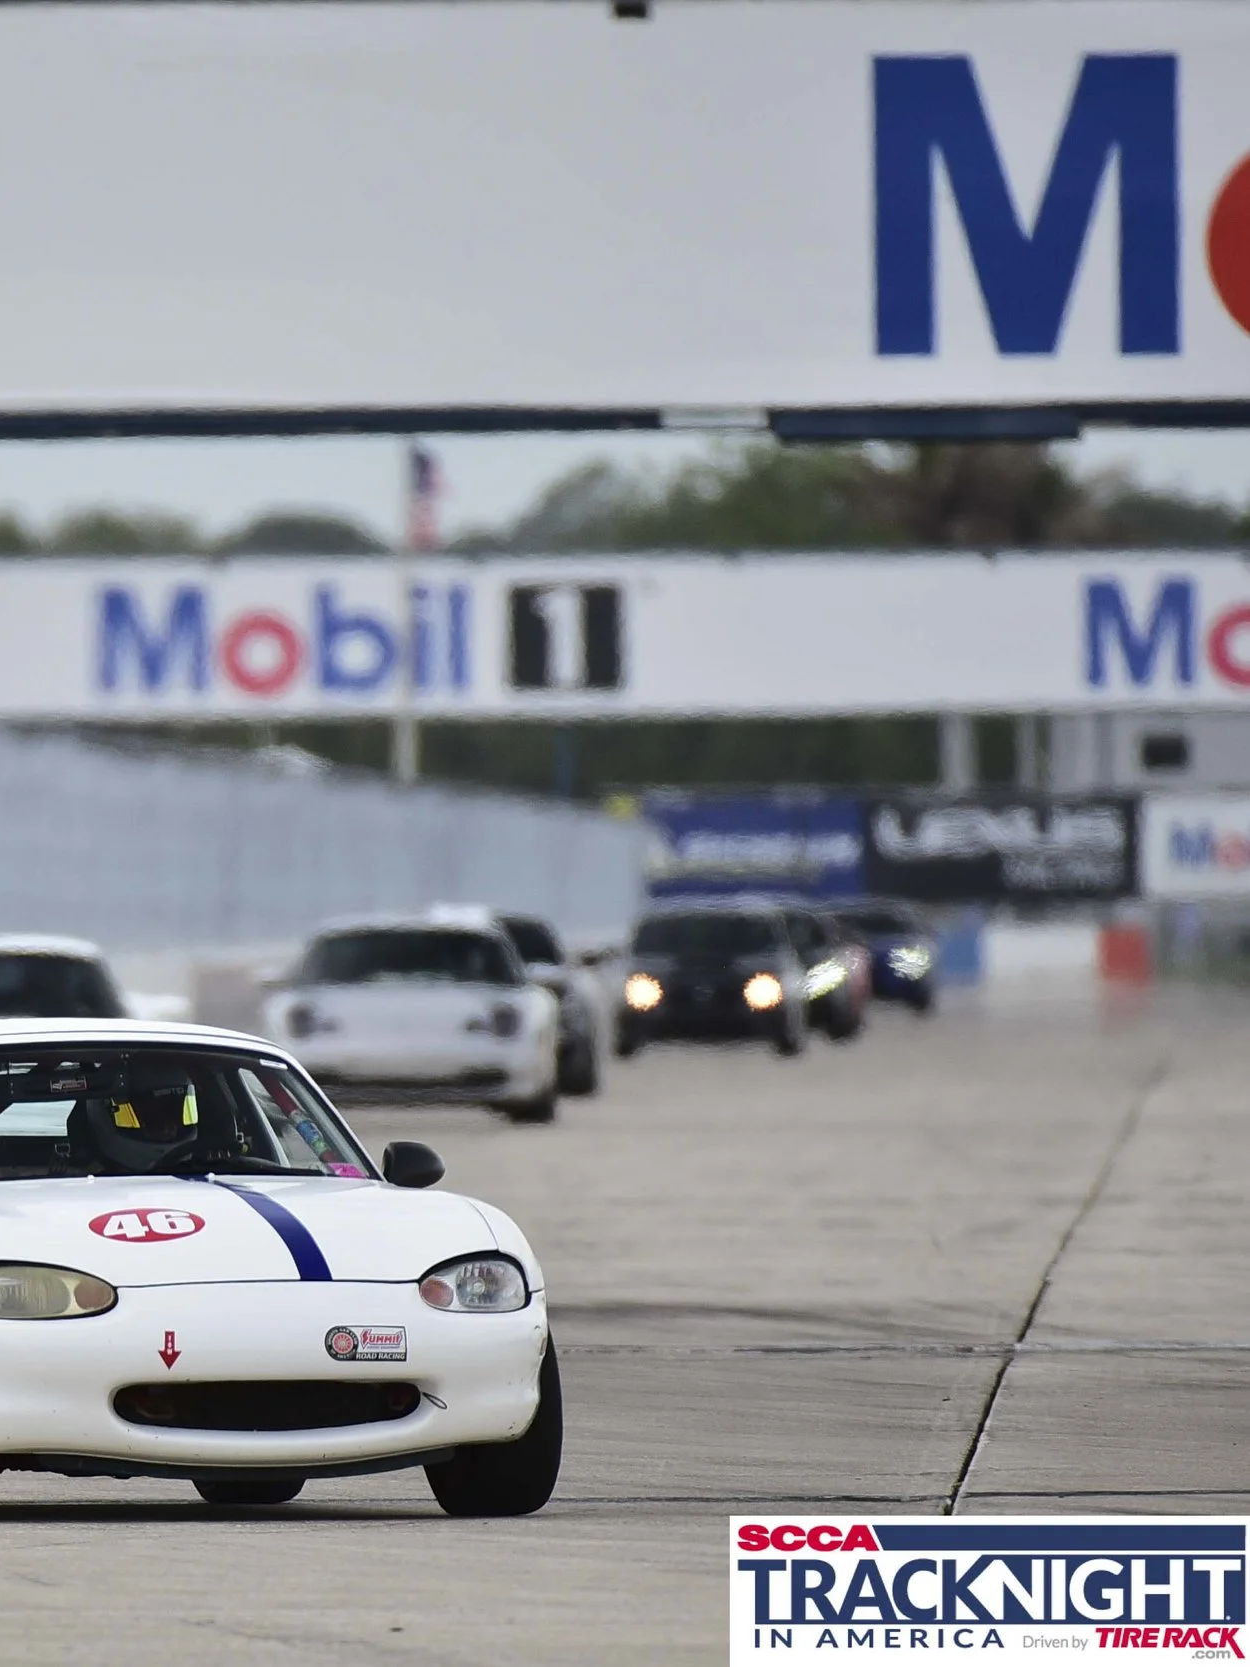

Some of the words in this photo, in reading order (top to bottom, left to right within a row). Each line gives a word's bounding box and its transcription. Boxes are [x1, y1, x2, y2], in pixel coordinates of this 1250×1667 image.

[871, 53, 1250, 356] M
[96, 583, 468, 694] Mobil
[528, 587, 586, 689] 1
[102, 1210, 196, 1239] 46
